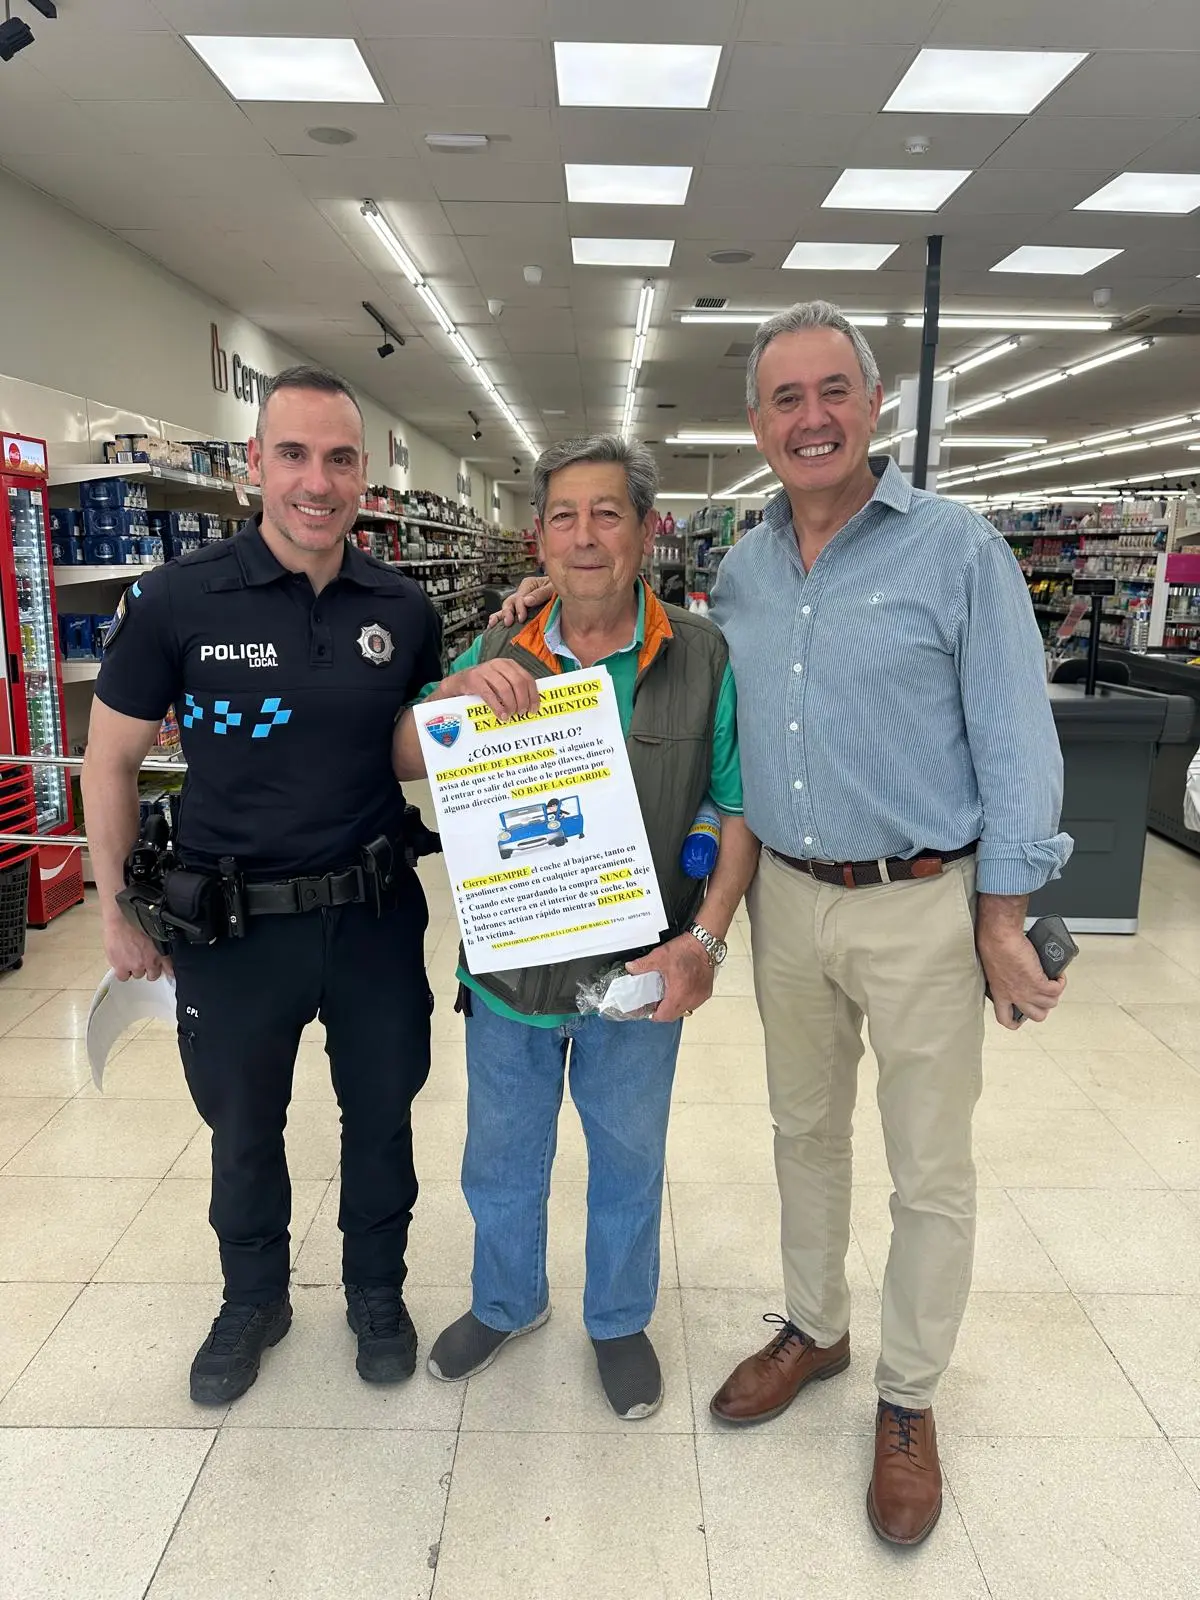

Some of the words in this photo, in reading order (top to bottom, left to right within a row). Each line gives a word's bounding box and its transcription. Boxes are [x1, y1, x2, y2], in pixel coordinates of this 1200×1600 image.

[200, 643, 277, 661] POLICIA
[249, 658, 278, 668] LOCAL
[549, 681, 599, 700] HURTOS
[474, 719, 491, 731] EN
[494, 695, 598, 727] AARCAMIENTOS
[468, 742, 512, 762] ¿CÓMO
[514, 726, 582, 750] EVITARLO?
[490, 760, 504, 769] DE
[567, 740, 595, 752] alguien
[439, 782, 459, 792] avisa
[460, 779, 470, 787] de
[471, 776, 486, 786] que
[540, 760, 557, 769] algo
[557, 754, 585, 766] (llaves,
[586, 746, 614, 759] dinero)
[441, 794, 449, 803] al
[450, 790, 475, 801] entrar
[483, 783, 500, 793] salir
[502, 779, 515, 789] del
[515, 775, 538, 786] coche
[545, 771, 553, 779] le
[554, 764, 590, 779] pregunta
[590, 760, 604, 770] por
[443, 803, 470, 814] alguna
[510, 788, 525, 798] NO
[526, 783, 550, 794] BAJE
[551, 780, 564, 789] LA
[462, 879, 487, 889] Cierre
[488, 868, 528, 883] SIEMPRE
[530, 865, 538, 874] el
[539, 861, 561, 872] coche
[562, 858, 571, 867] al
[571, 853, 604, 865] bajarse,
[604, 847, 625, 857] tanto
[465, 885, 508, 901] gasolineras
[508, 880, 530, 890] como
[542, 869, 578, 883] cualquier
[580, 856, 635, 875] aparcamiento.
[468, 899, 499, 912] Cuando
[516, 886, 558, 902] guardando
[568, 878, 598, 890] compra
[599, 869, 632, 883] NUNCA
[633, 865, 650, 875] deje
[470, 912, 492, 922] bolso
[499, 905, 527, 916] cartera
[539, 898, 547, 907] el
[547, 894, 577, 905] interior
[578, 890, 588, 899] de
[473, 920, 507, 932] ladrones
[507, 914, 534, 925] actúan
[535, 907, 561, 919] rápido
[562, 901, 596, 913] mientras
[596, 888, 644, 906] DISTRAEN
[186, 1006, 198, 1018] CPL
